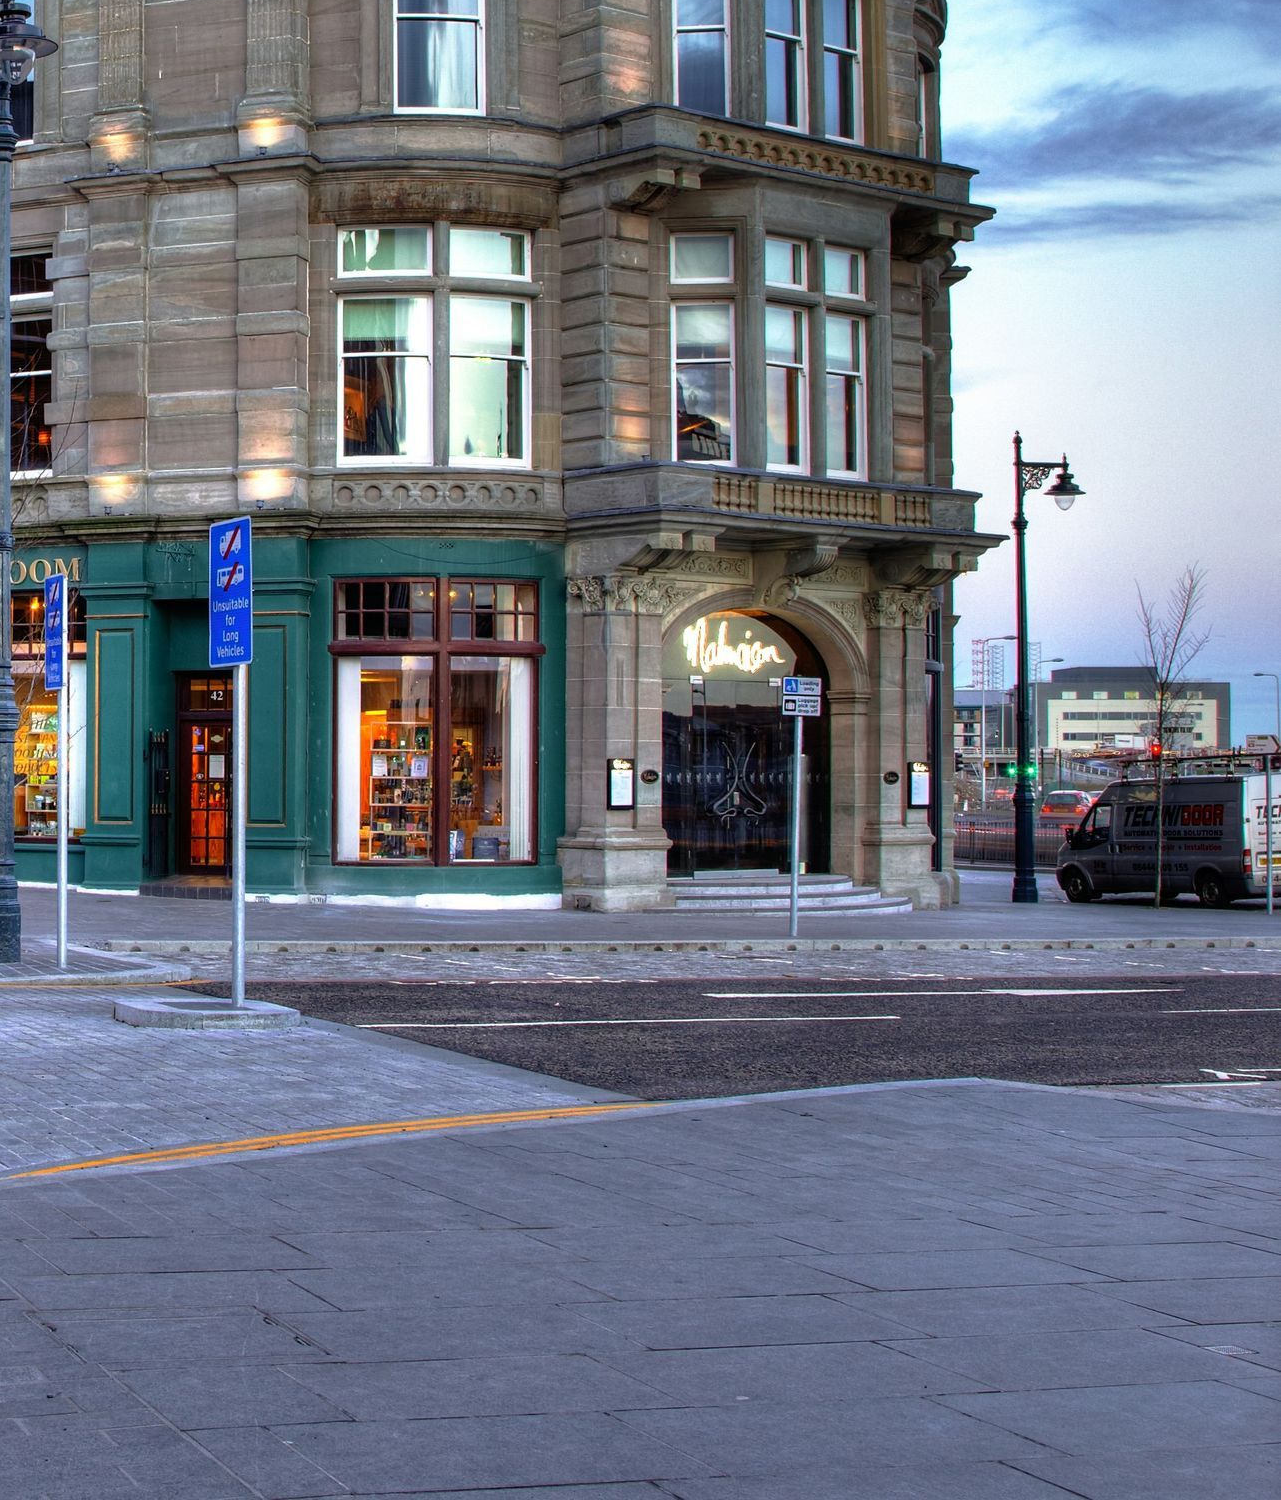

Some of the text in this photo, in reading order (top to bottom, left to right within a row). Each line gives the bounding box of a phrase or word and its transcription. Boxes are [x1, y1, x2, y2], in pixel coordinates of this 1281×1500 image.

[212, 596, 249, 612] Unsuitable
[225, 614, 236, 626] for
[222, 630, 239, 643] Long
[216, 645, 245, 658] Vehicles
[210, 691, 223, 700] 42
